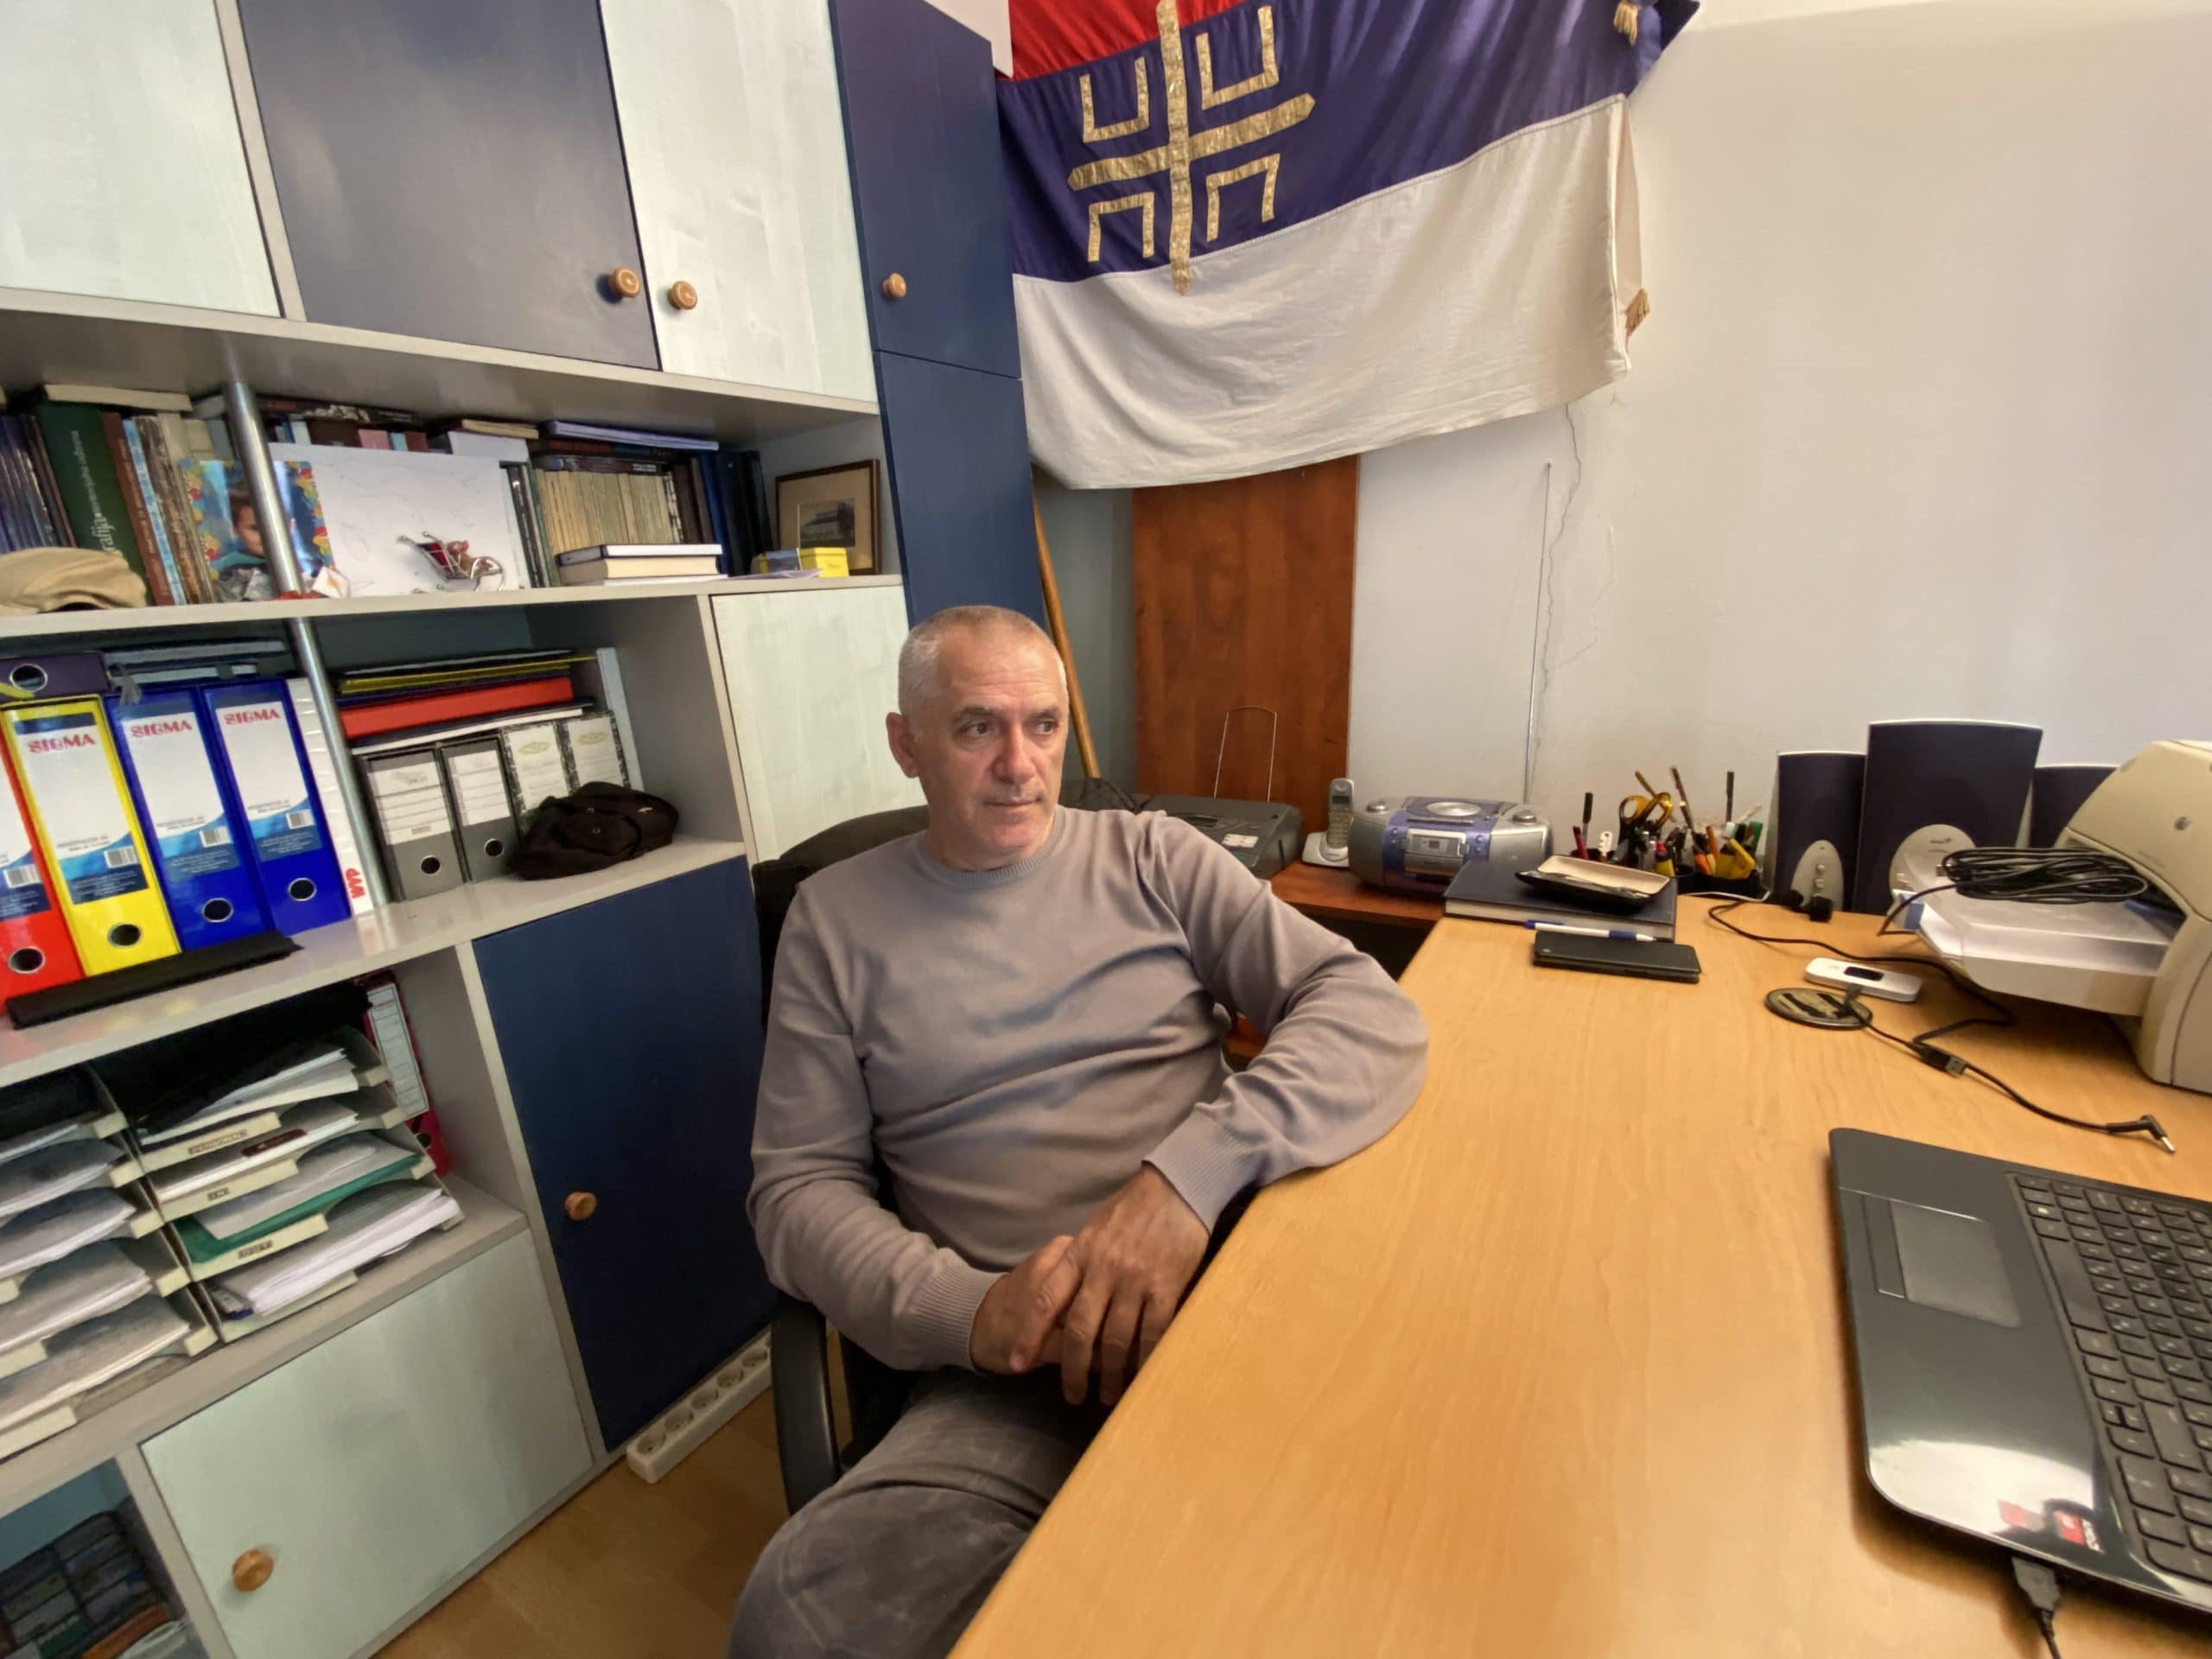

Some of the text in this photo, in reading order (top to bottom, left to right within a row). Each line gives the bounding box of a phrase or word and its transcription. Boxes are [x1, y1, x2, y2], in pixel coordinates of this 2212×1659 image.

[225, 709, 281, 725] SIGMA
[130, 720, 192, 738] SIGMA
[28, 734, 95, 753] SIGMA
